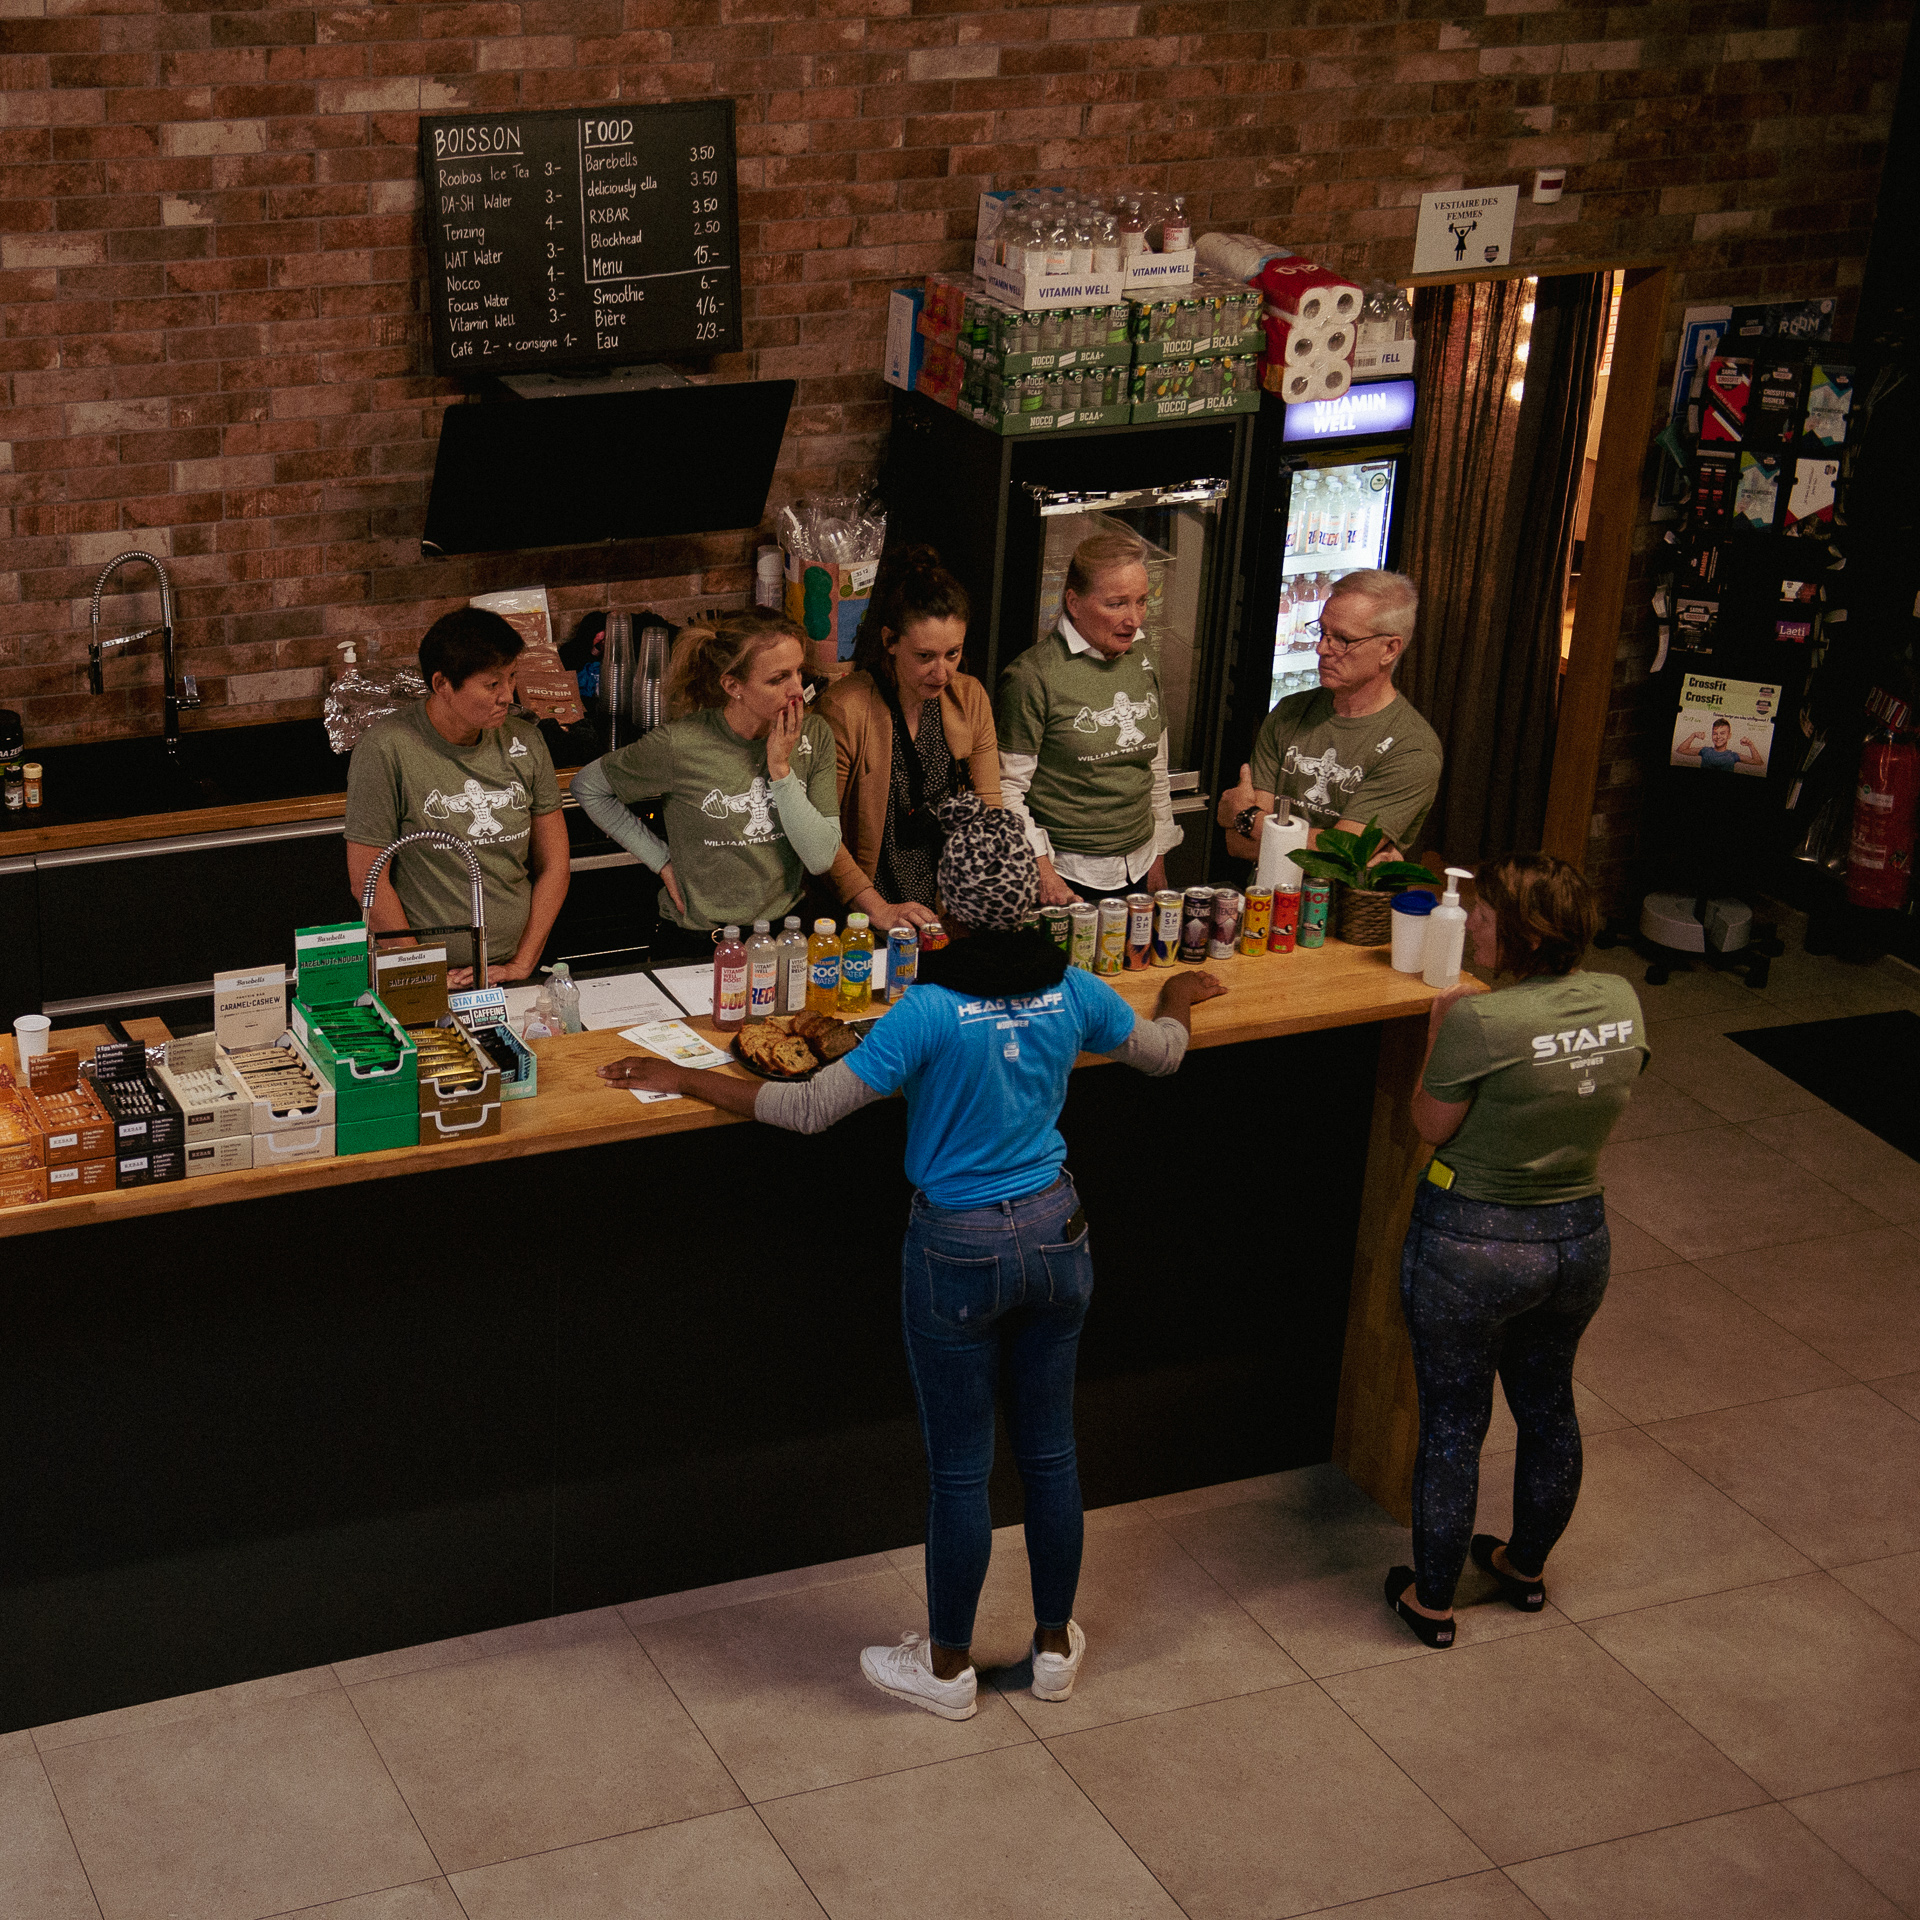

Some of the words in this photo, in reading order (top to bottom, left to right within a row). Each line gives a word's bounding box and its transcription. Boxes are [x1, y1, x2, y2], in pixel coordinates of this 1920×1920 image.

[584, 119, 633, 144] FOOD
[434, 126, 521, 157] BOISSON
[585, 151, 638, 172] Barebells
[689, 145, 715, 162] 3.50
[439, 168, 482, 189] Rooibos
[490, 166, 507, 181] Ice
[512, 163, 530, 179] Tea
[690, 170, 718, 187] 3.50
[587, 177, 637, 199] deliciously
[640, 175, 658, 191] ella
[441, 194, 475, 215] DA-SH
[483, 193, 513, 210] Water
[692, 197, 718, 214] 3.50
[1434, 199, 1480, 211] VESTIAIRE
[1481, 197, 1499, 208] DES
[589, 207, 630, 224] RXBAR
[1446, 209, 1483, 221] FEMMES
[442, 223, 485, 246] Tenzing
[693, 220, 721, 236] 2.50
[590, 229, 642, 249] Blockhead
[444, 250, 469, 271] WAT
[473, 248, 504, 266] Water
[592, 257, 623, 277] Menu
[1132, 265, 1169, 278] VITAMIN
[1171, 264, 1190, 275] WELL
[446, 275, 481, 293] Nocco
[1039, 287, 1083, 299] VITAMIN
[1085, 284, 1111, 297] WELL
[448, 297, 479, 314] Focus
[483, 293, 510, 308] Water
[592, 284, 645, 305] Smoothie
[449, 315, 489, 333] Vitamin
[494, 314, 517, 328] Well
[594, 309, 627, 328] Bière
[450, 341, 473, 359] Café
[515, 339, 559, 353] consigne
[596, 331, 619, 350] Eau
[1163, 339, 1193, 354] NOCCO
[1212, 334, 1244, 350] BCAA+
[1031, 355, 1055, 367] NOCCO
[1081, 351, 1105, 362] BCAA+
[1157, 400, 1187, 415] NOCCO
[1206, 395, 1239, 410] BCAA+
[1314, 392, 1387, 417] VITAMIN
[1030, 414, 1054, 427] NOCCO
[1079, 411, 1104, 422] BCAA+
[1313, 412, 1357, 434] WELL
[1779, 625, 1807, 637] Laeti
[526, 687, 573, 698] PROTEIN
[1688, 676, 1727, 692] CrossFit
[1685, 691, 1724, 706] CrossFit
[1078, 750, 1119, 762] WILLIAM
[473, 837, 496, 846] TELL
[703, 838, 747, 848] WILLIAM
[747, 835, 769, 846] TELL
[235, 976, 266, 987] Barebells
[452, 996, 475, 1008] STAY
[476, 992, 502, 1005] ALERT
[957, 998, 1007, 1018] HEAD
[1010, 991, 1064, 1011] STAFF
[473, 1006, 506, 1019] CAFFEINE
[1531, 1019, 1634, 1059] STAFF
